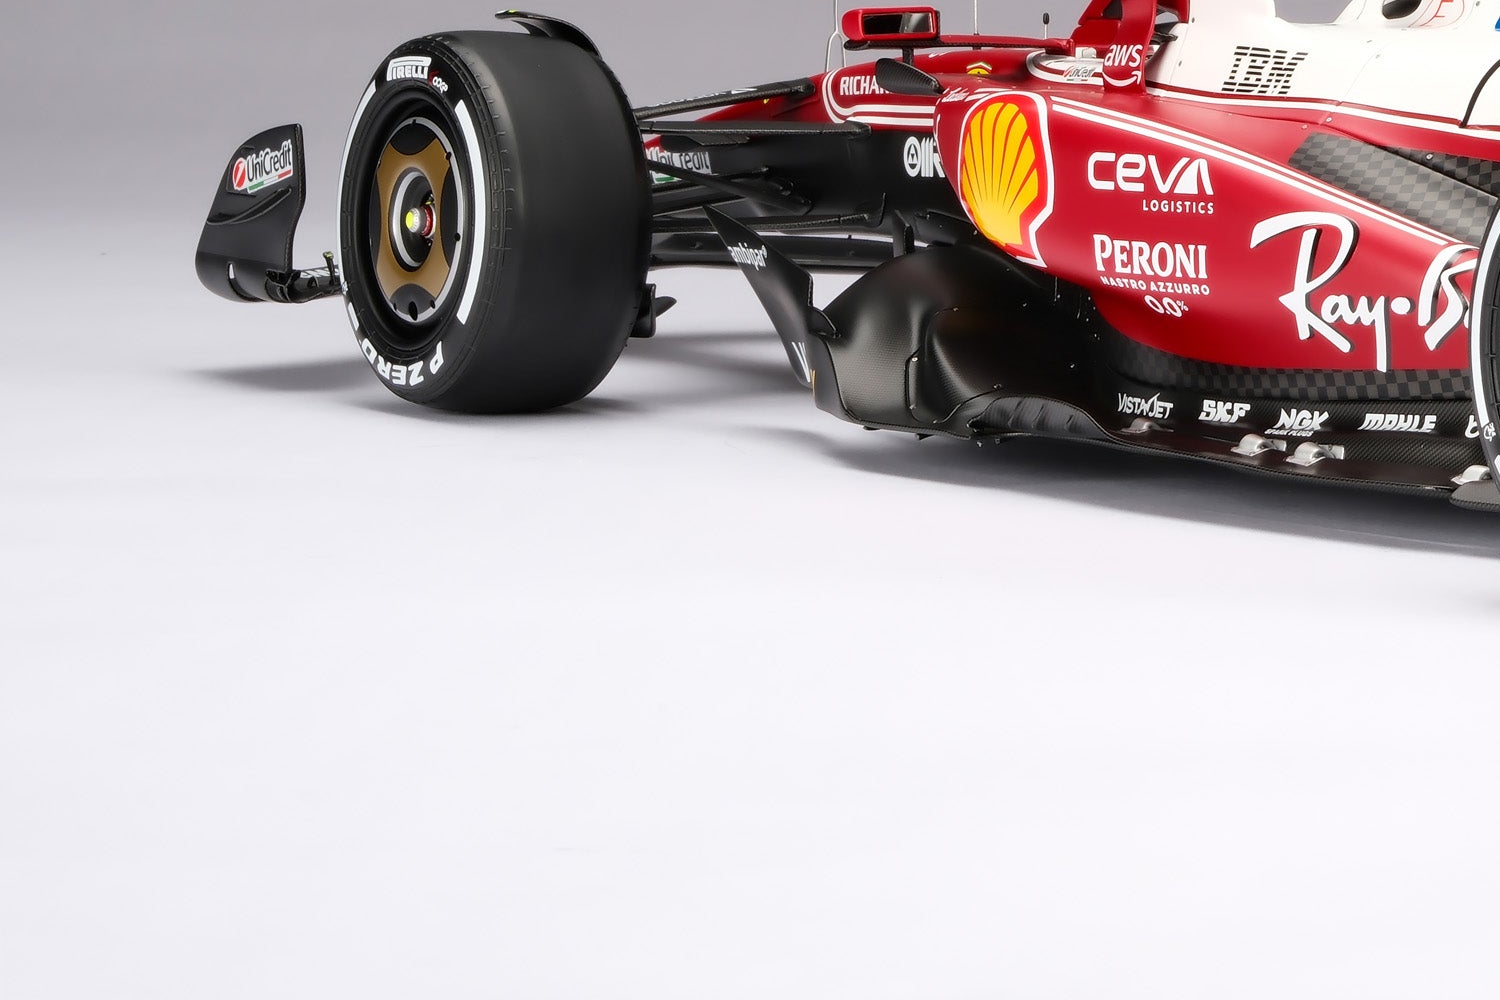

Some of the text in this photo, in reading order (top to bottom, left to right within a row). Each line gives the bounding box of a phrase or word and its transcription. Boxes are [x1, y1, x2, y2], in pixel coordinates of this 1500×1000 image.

[1104, 44, 1143, 67] aws
[387, 56, 431, 81] PIRELLI
[1221, 46, 1308, 94] IBM
[247, 141, 292, 182] UniCredit
[1142, 199, 1214, 215] LOGISTICS
[1093, 234, 1208, 279] PERONI
[1100, 275, 1210, 296] NASTRO AZZURRO
[1144, 295, 1189, 318] 0.0%
[361, 338, 444, 386] P ZERO
[1198, 399, 1250, 423] SKF
[1272, 408, 1329, 431] NGK
[1357, 413, 1437, 433] MAHLE
